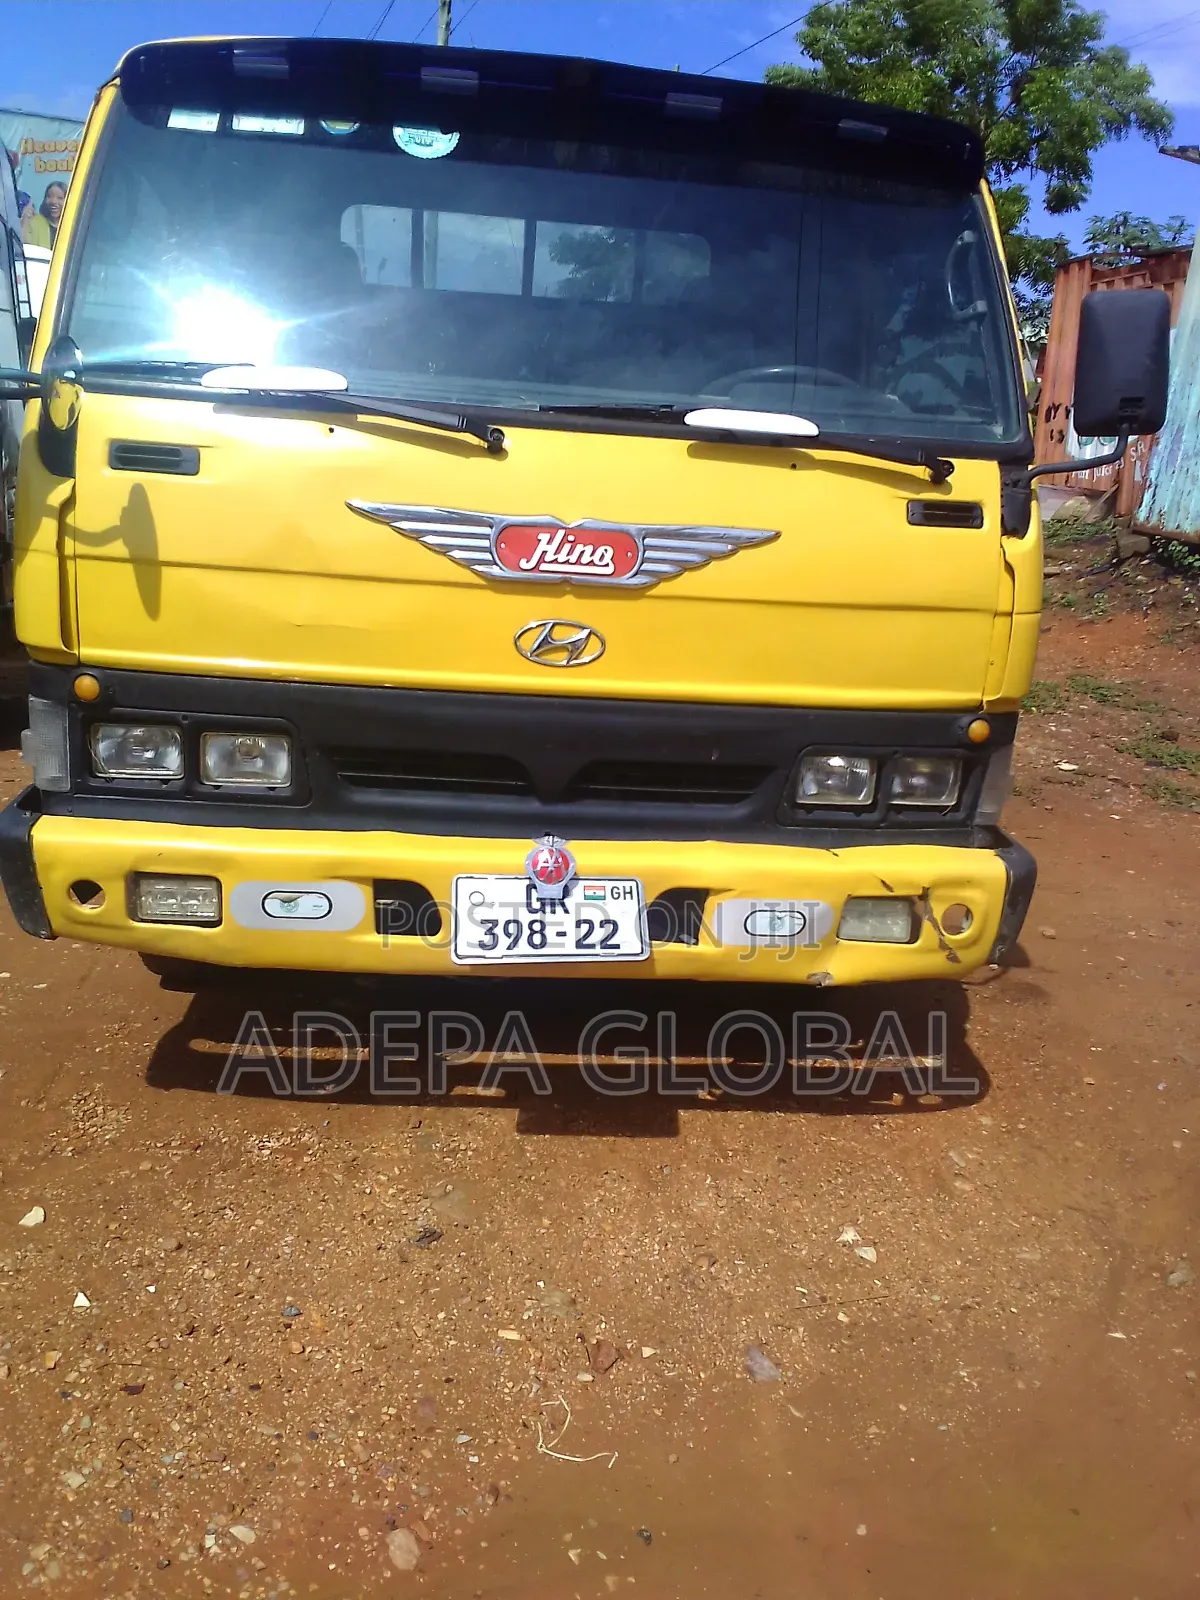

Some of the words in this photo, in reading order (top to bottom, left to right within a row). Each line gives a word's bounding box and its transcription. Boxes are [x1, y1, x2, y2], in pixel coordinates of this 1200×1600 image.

[519, 529, 615, 575] Hino
[610, 885, 634, 901] GH
[478, 917, 621, 952] 398-22
